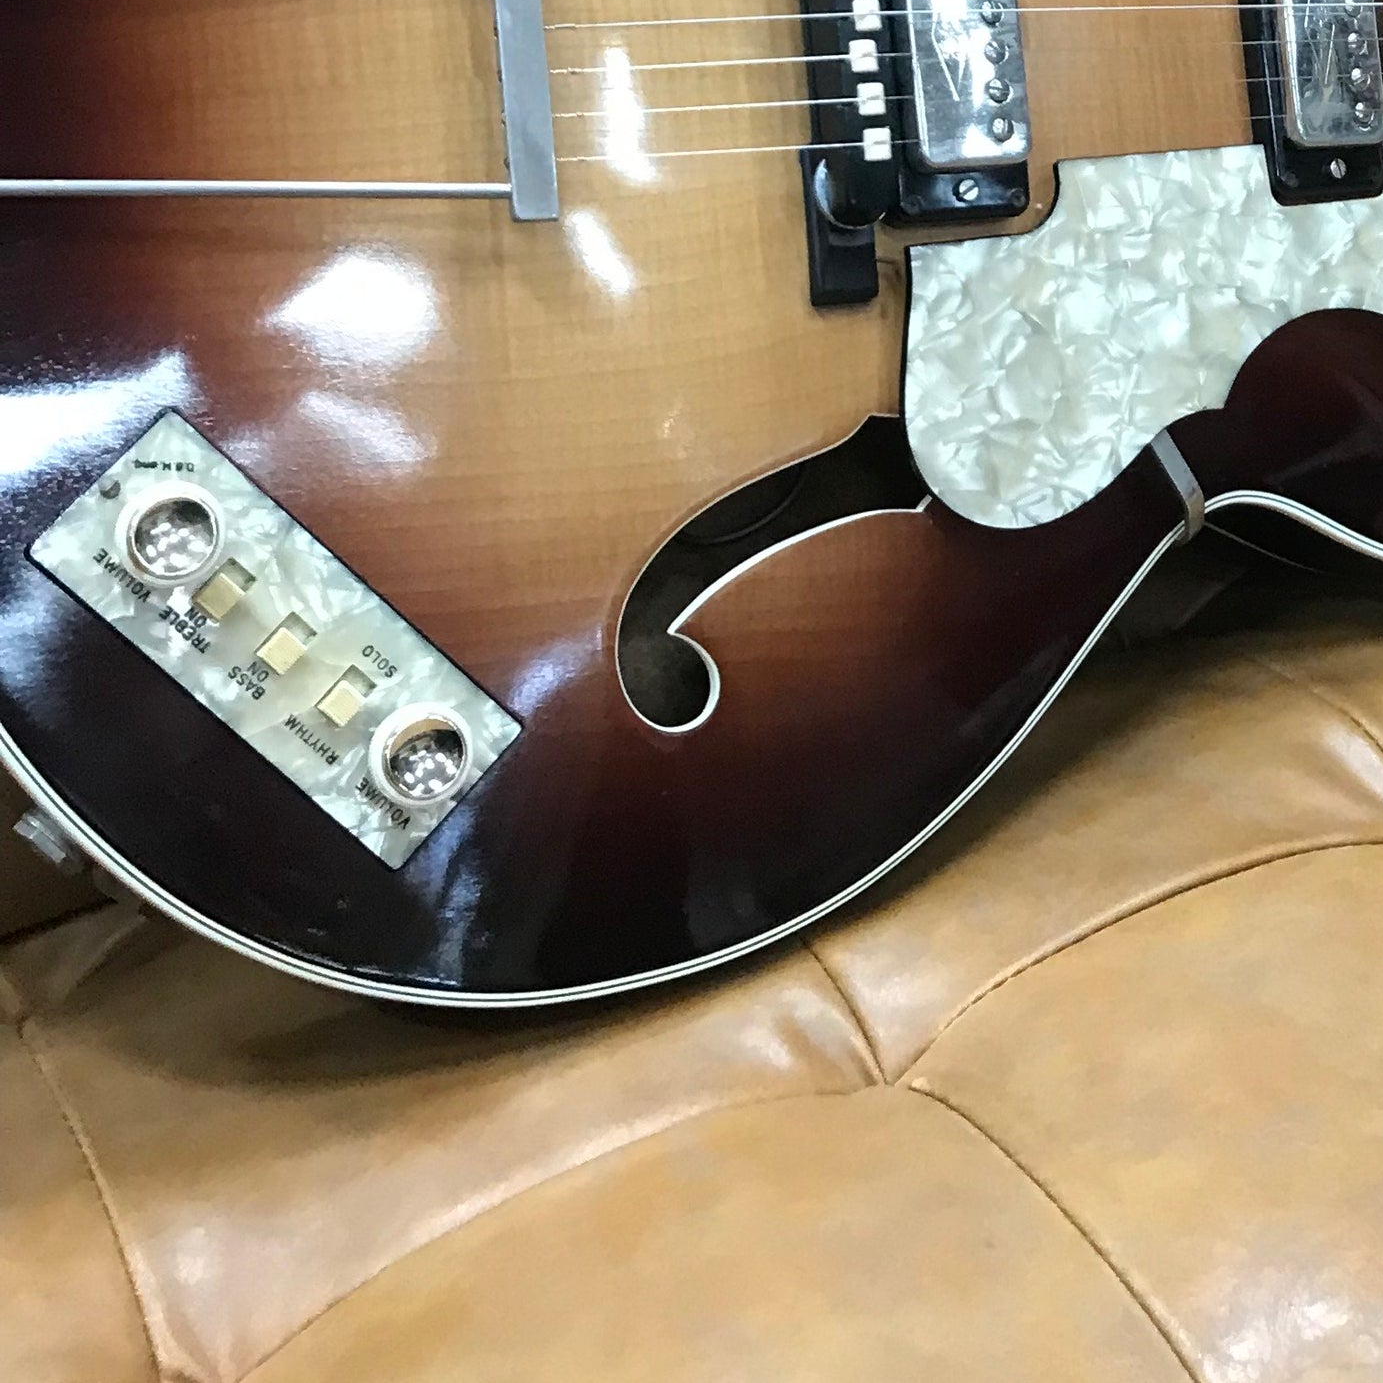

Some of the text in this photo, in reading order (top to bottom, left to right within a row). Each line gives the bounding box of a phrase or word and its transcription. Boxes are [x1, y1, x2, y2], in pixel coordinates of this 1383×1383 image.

[93, 548, 151, 603] VOLUME
[158, 605, 211, 654] TREBLE
[184, 606, 207, 629] ON
[247, 661, 270, 683] ON
[362, 645, 397, 678] SOLO
[227, 666, 266, 700] BASS
[284, 714, 340, 765] RHYTHM
[355, 777, 411, 830] VOLUME
